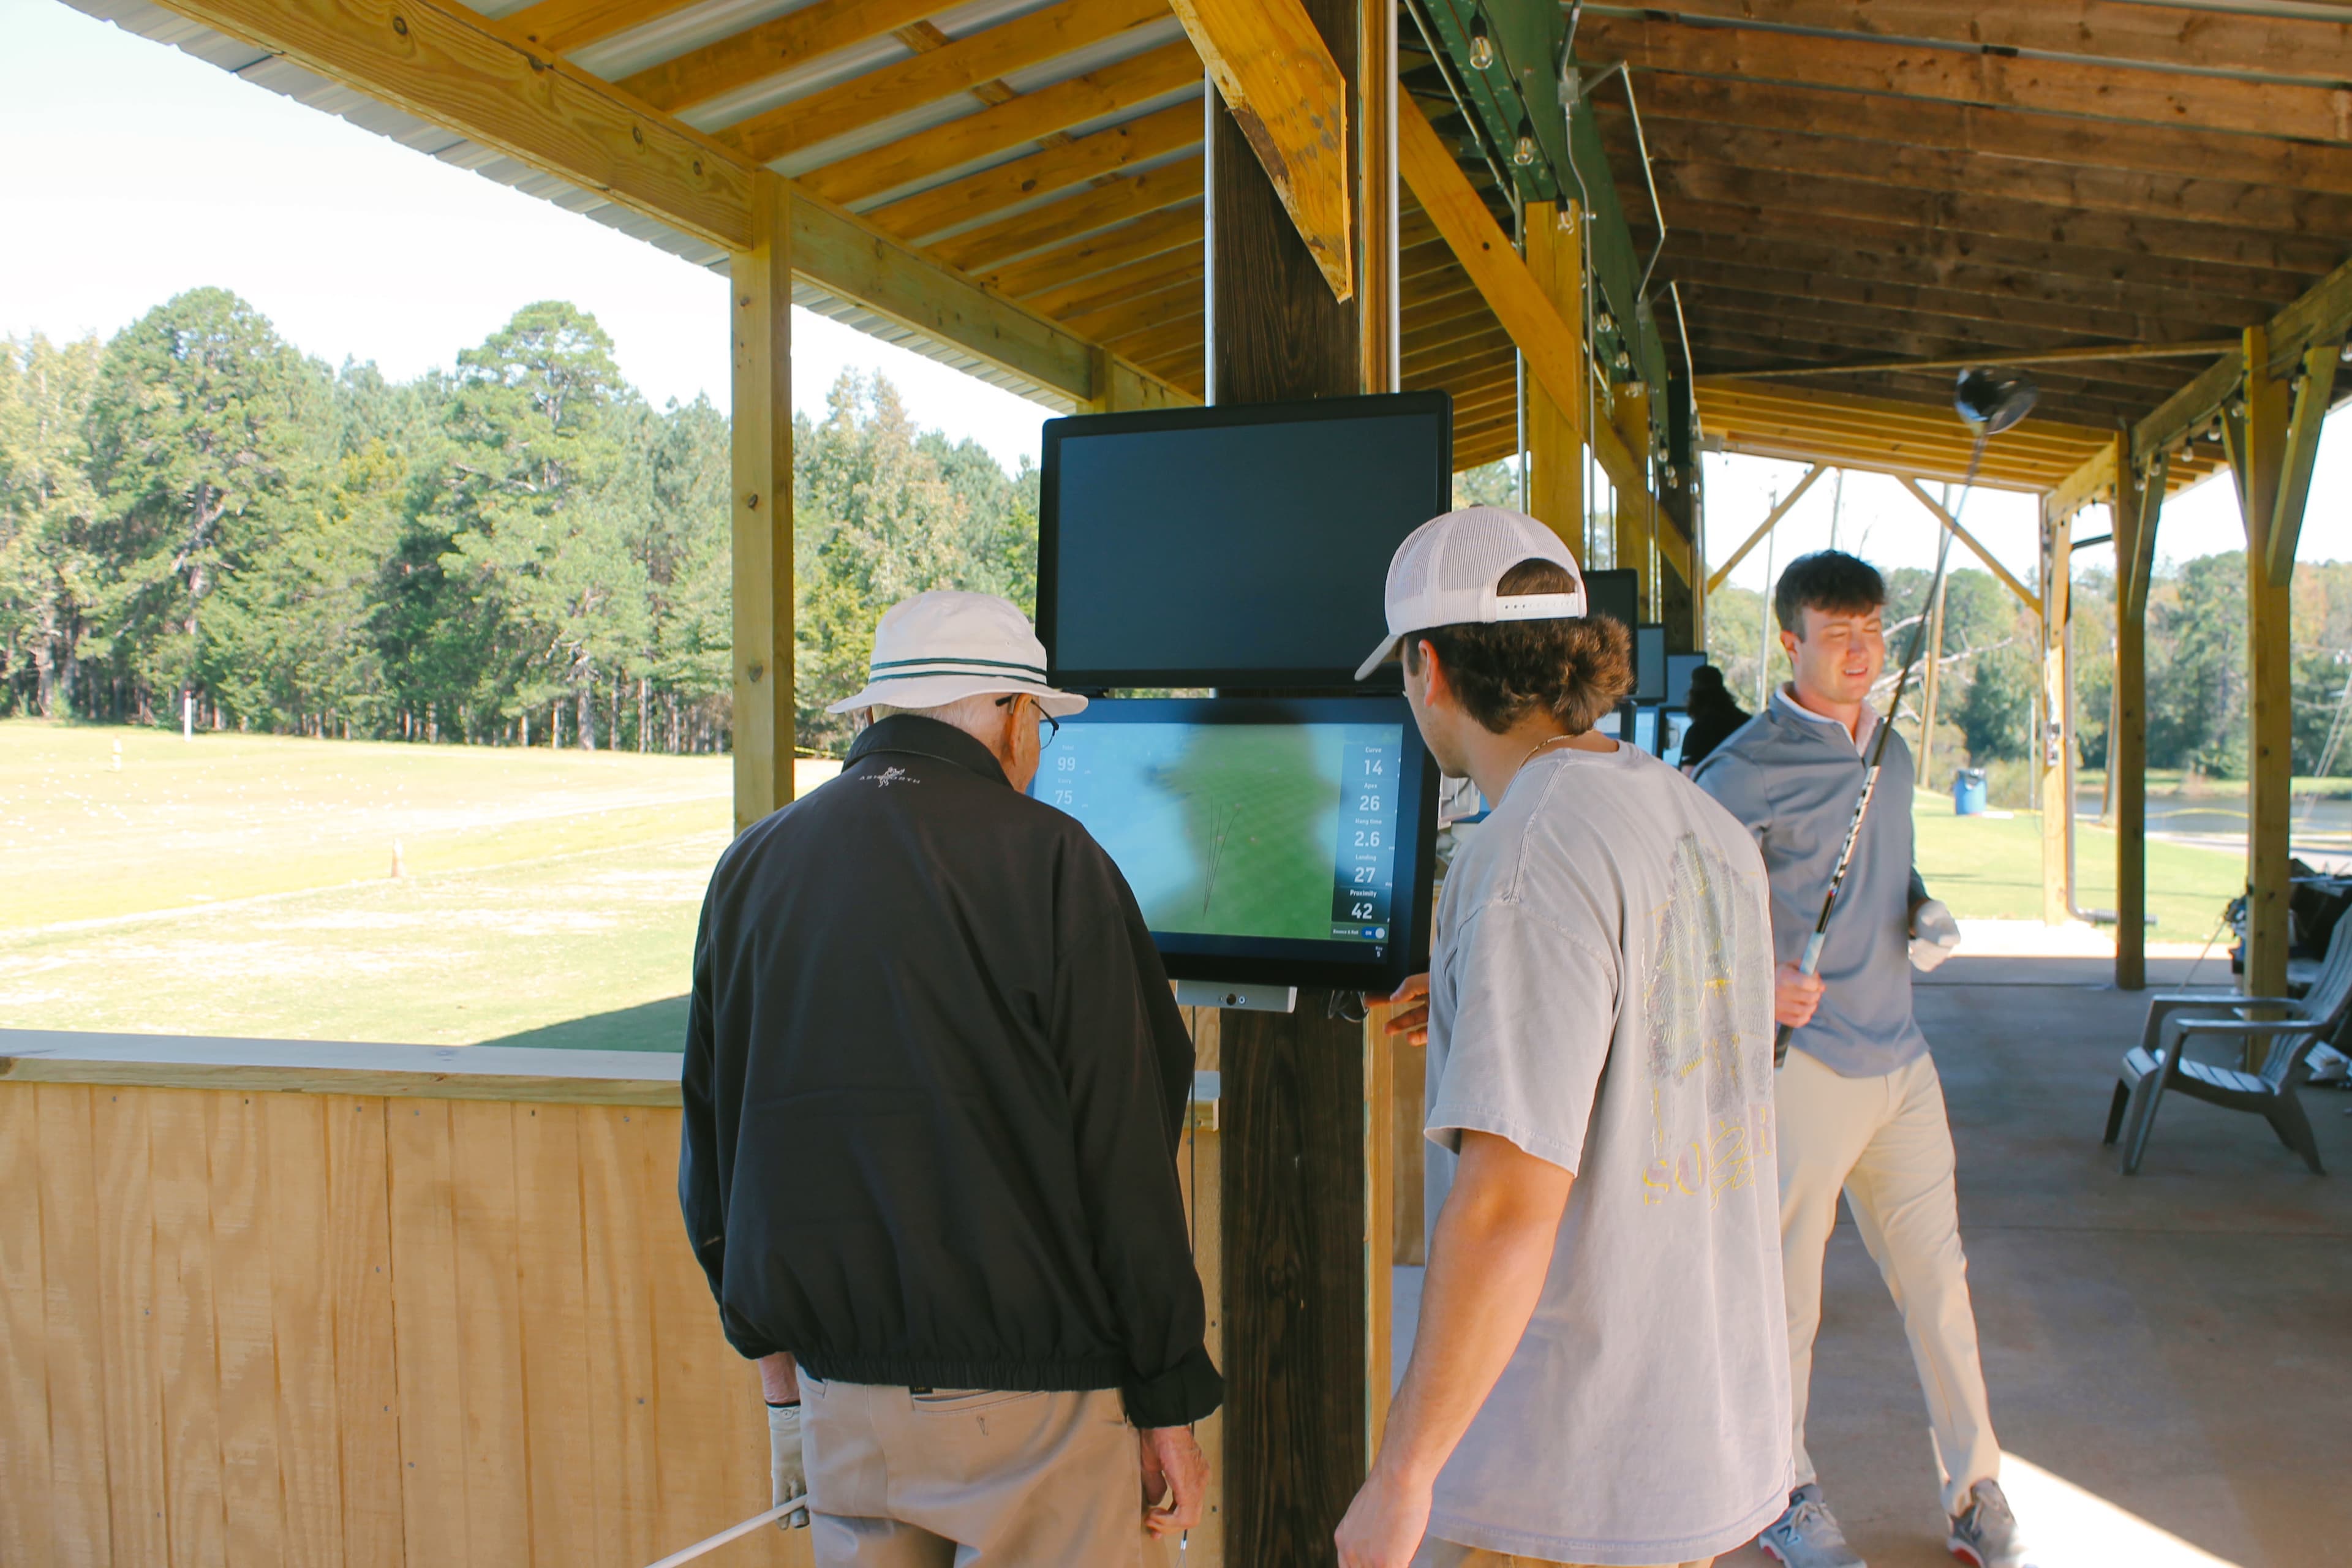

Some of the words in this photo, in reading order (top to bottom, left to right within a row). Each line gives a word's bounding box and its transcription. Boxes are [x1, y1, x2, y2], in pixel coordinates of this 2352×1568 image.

[1058, 757, 1076, 771] 99
[1365, 759, 1382, 775] 14
[1055, 790, 1072, 804] 75
[1359, 795, 1380, 811] 26
[1354, 831, 1380, 847] 2.6
[1354, 867, 1376, 883] 27
[1350, 889, 1378, 899] Proximity
[1351, 902, 1373, 919] 42
